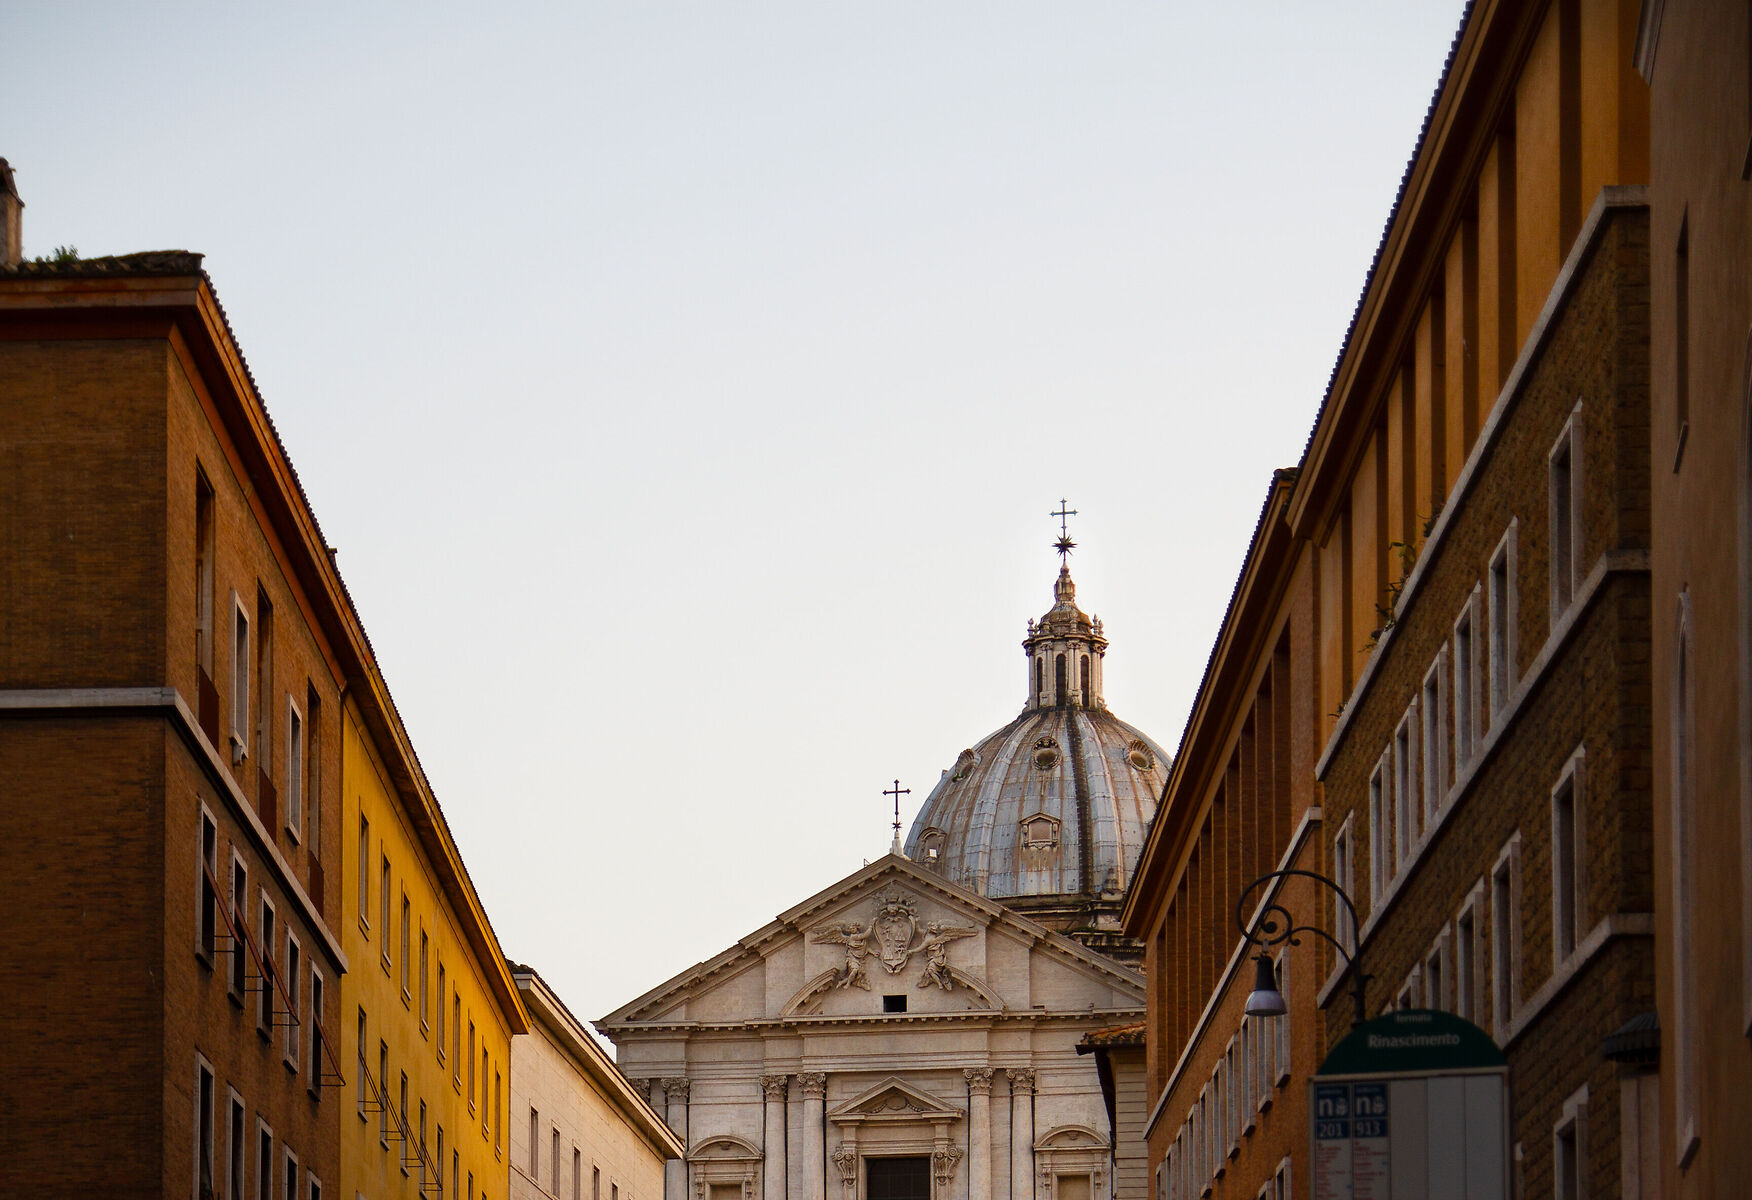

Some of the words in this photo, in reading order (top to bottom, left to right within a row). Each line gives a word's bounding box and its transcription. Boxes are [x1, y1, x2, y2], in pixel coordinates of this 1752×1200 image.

[1367, 1032, 1461, 1049] Rinascimento
[1319, 1122, 1343, 1137] 201
[1356, 1120, 1381, 1136] 913
